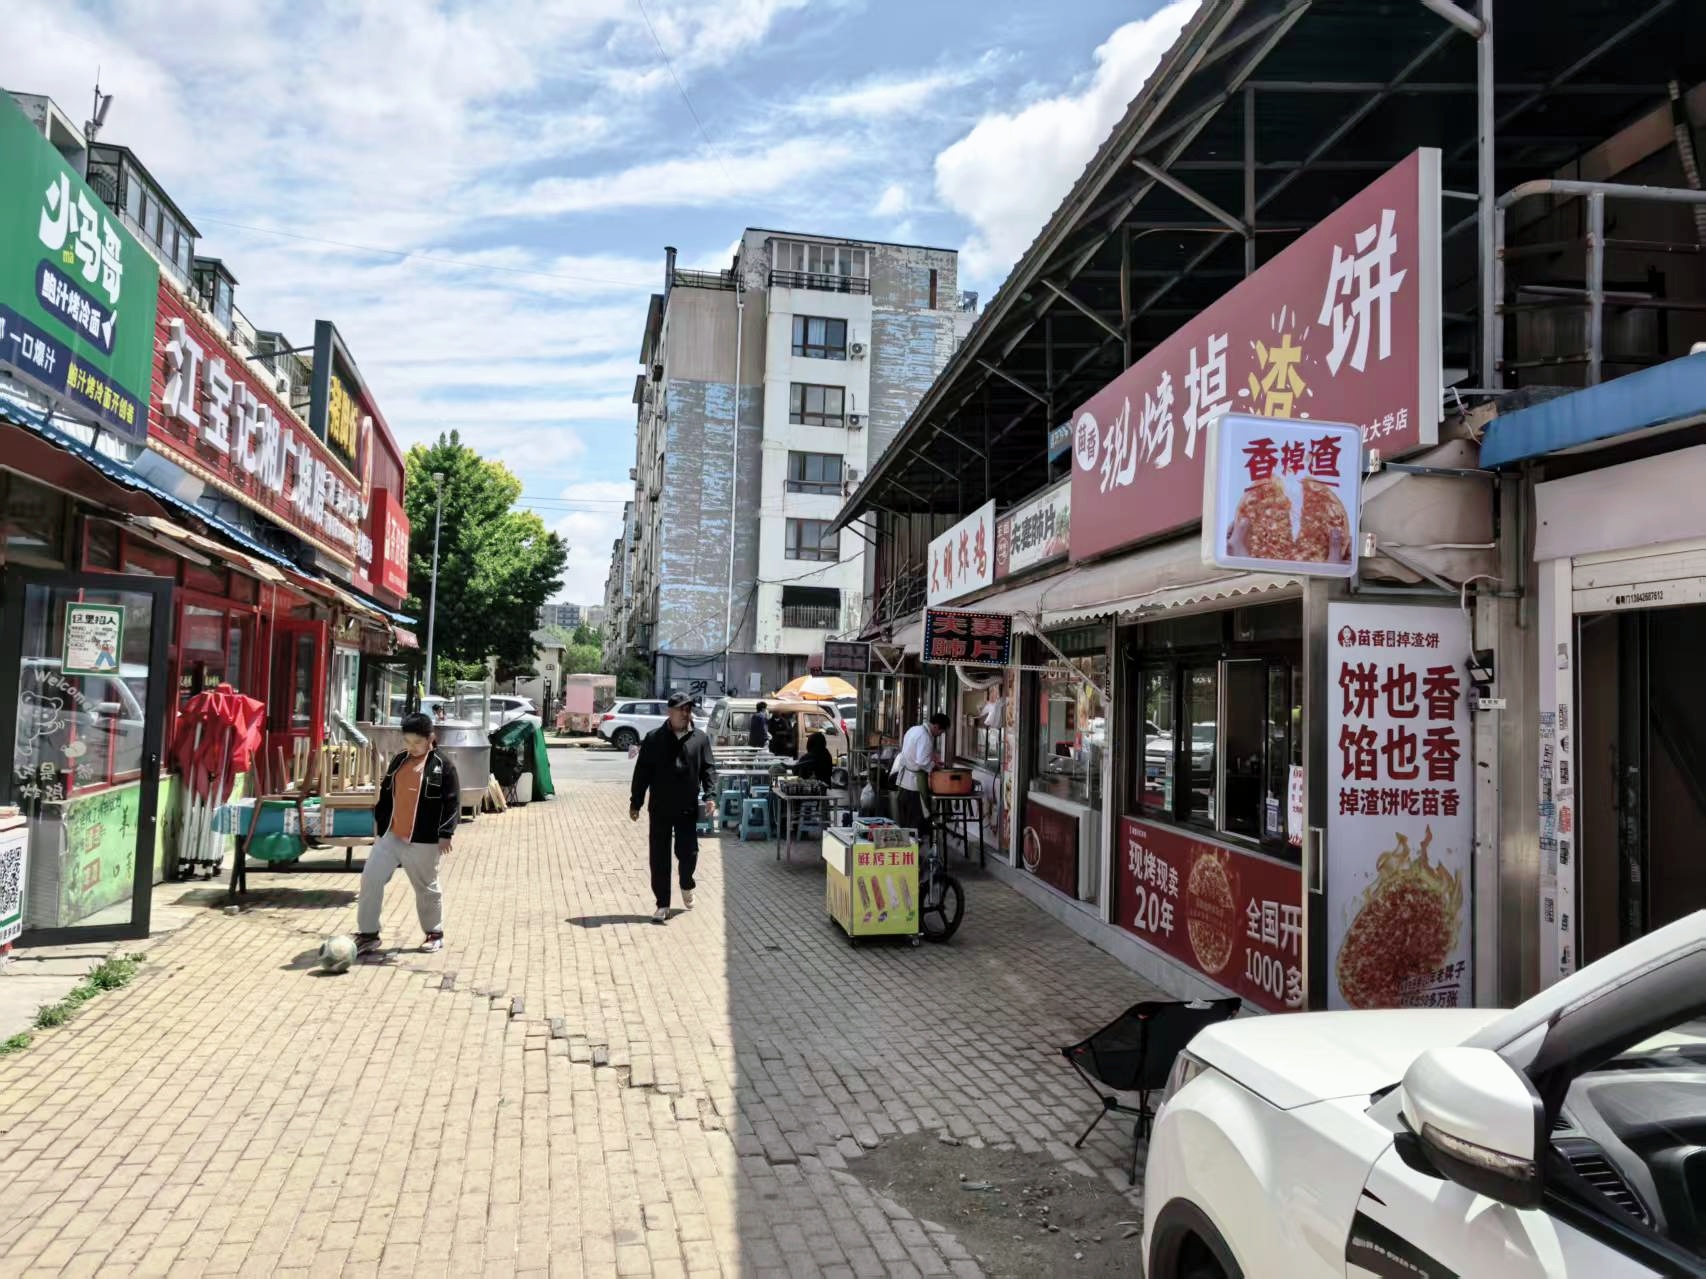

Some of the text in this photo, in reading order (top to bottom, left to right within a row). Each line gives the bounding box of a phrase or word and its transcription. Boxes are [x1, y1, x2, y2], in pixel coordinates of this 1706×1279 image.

[38, 171, 123, 304] 小马哥
[41, 269, 101, 339] 鲍汁烤冷面
[1241, 434, 1342, 481] 香掉渣
[1010, 503, 1056, 555] 夫妻肺片
[932, 616, 1005, 637] 夫妻
[1357, 628, 1384, 647] 苗香
[1396, 631, 1440, 649] 掉渣饼
[1338, 661, 1461, 721] 饼也香
[1338, 723, 1461, 782] 馅也香
[1338, 787, 1460, 817] 掉渣饼吃苗香
[1128, 838, 1179, 899] 现烤现卖
[1133, 884, 1175, 938] 20年
[1246, 896, 1302, 956] 全国开
